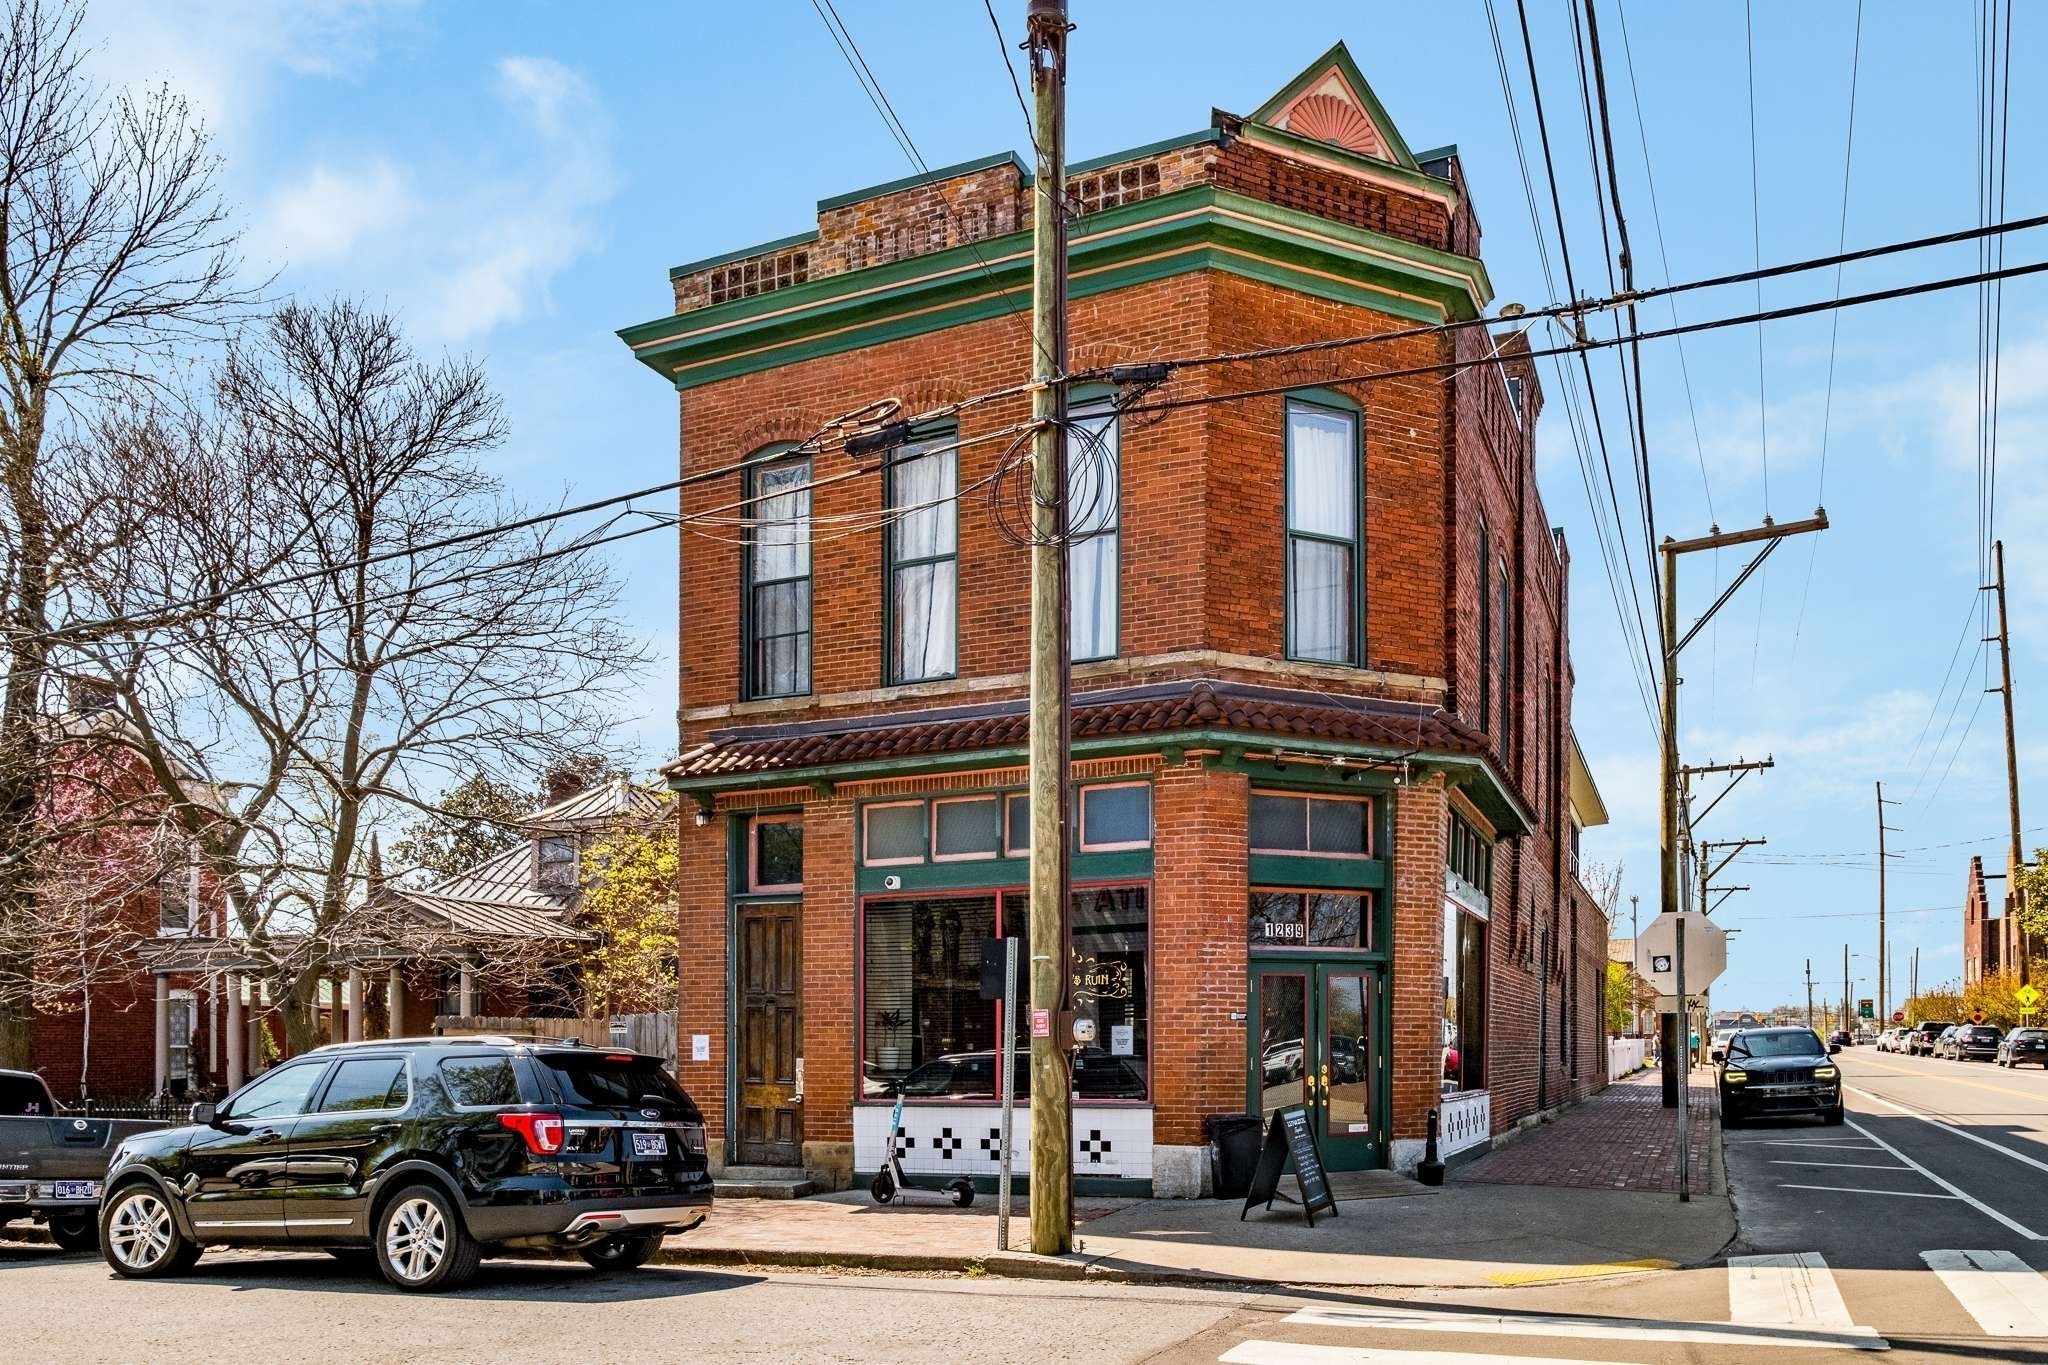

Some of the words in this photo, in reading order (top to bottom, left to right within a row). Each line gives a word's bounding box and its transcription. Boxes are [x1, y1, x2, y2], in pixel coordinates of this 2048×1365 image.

[1266, 924, 1303, 937] 1239
[1085, 974, 1109, 985] RUIN
[636, 1140, 647, 1150] 519
[57, 1185, 71, 1195] 016
